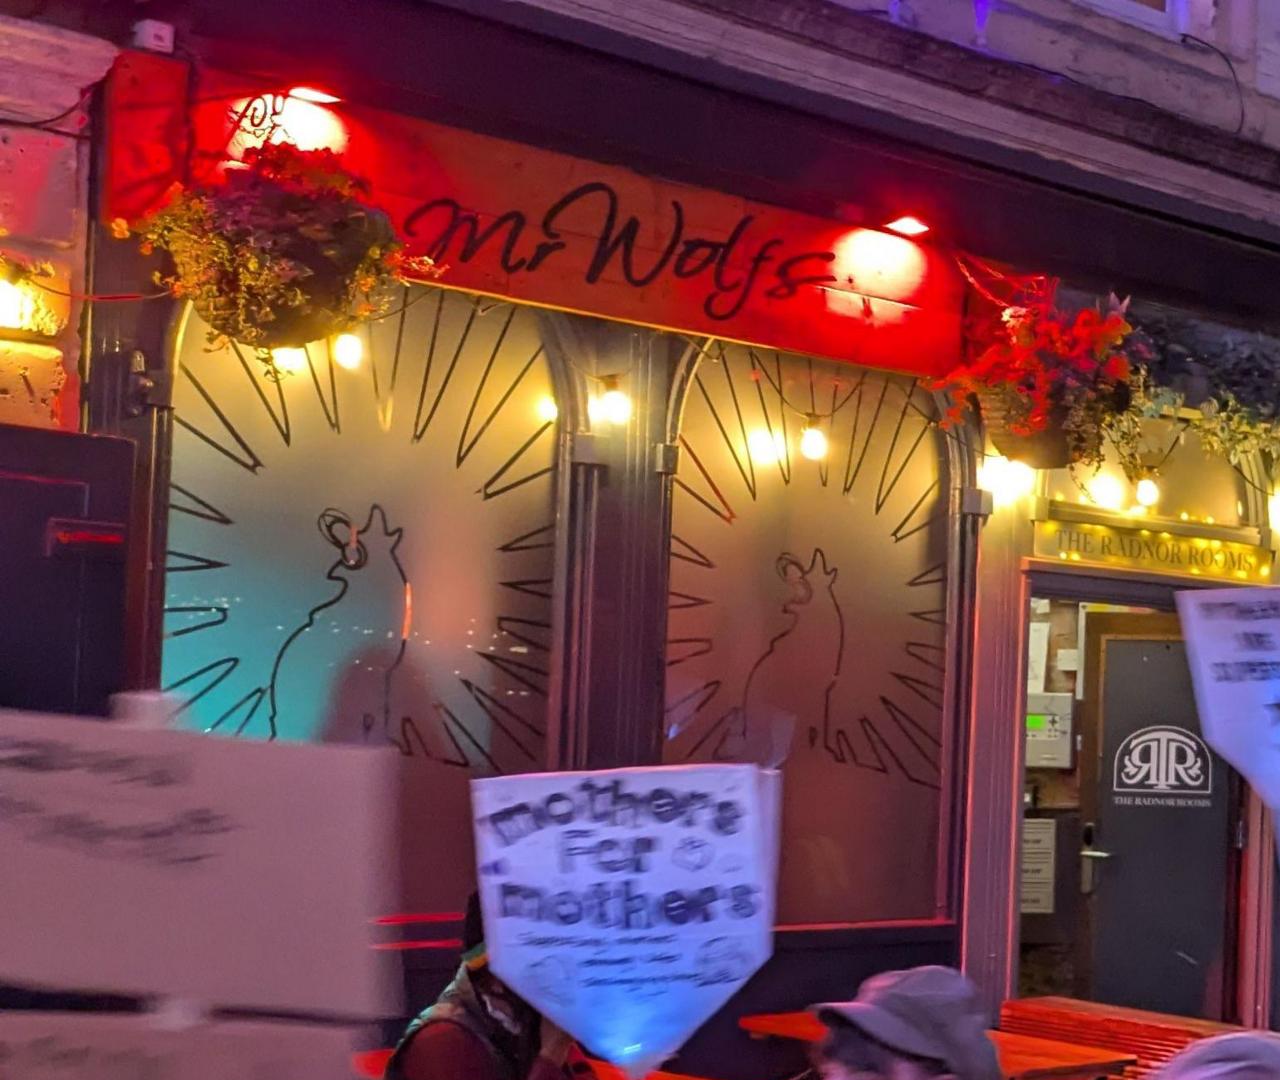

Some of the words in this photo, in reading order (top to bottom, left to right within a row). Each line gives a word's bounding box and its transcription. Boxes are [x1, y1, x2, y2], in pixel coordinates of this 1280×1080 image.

[403, 199, 566, 273] Mr
[1055, 528, 1094, 552] THE
[1101, 534, 1183, 564] RADNOR
[1187, 546, 1255, 571] ROOMS
[1114, 796, 1133, 806] THE
[1135, 797, 1175, 808] RADNOR
[1176, 798, 1212, 808] ROOMS
